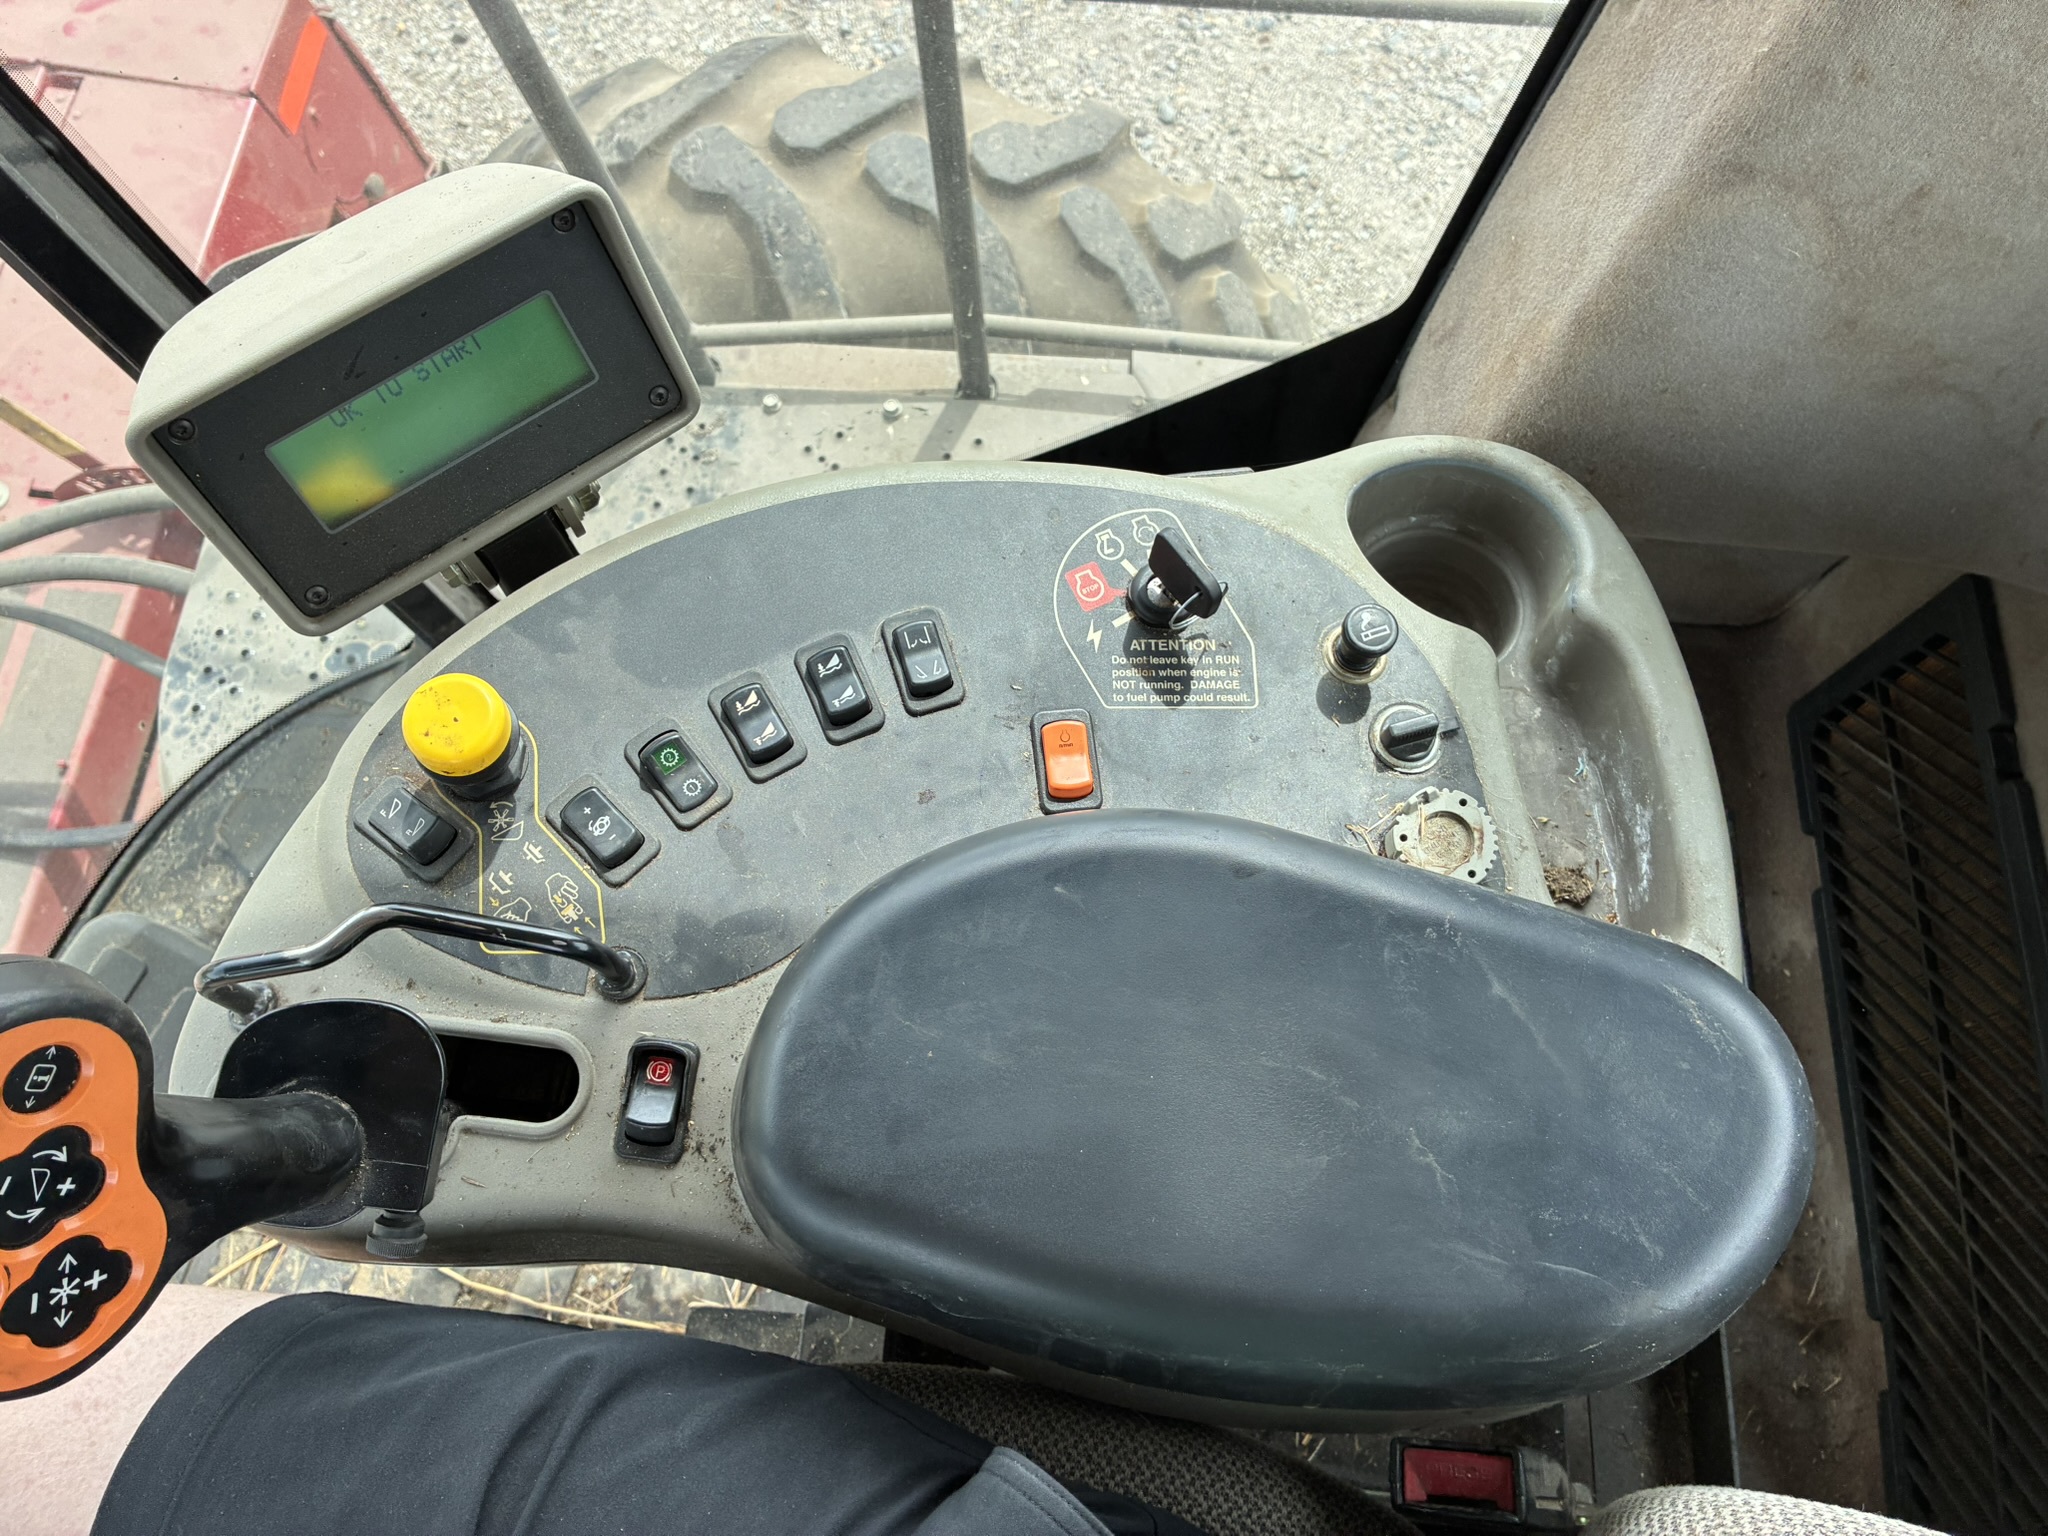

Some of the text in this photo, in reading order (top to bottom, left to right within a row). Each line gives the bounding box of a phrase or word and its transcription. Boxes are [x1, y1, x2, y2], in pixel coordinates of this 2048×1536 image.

[1082, 583, 1099, 594] STOP
[1130, 639, 1217, 651] ATTENTION
[1112, 655, 1239, 666] Do not leave key in RUN
[1112, 668, 1238, 679] position when engine is
[1112, 680, 1240, 691] NOT running. DAMAGE
[1113, 693, 1250, 703] to fuel pump could result.
[379, 808, 387, 818] F
[655, 1065, 666, 1077] P
